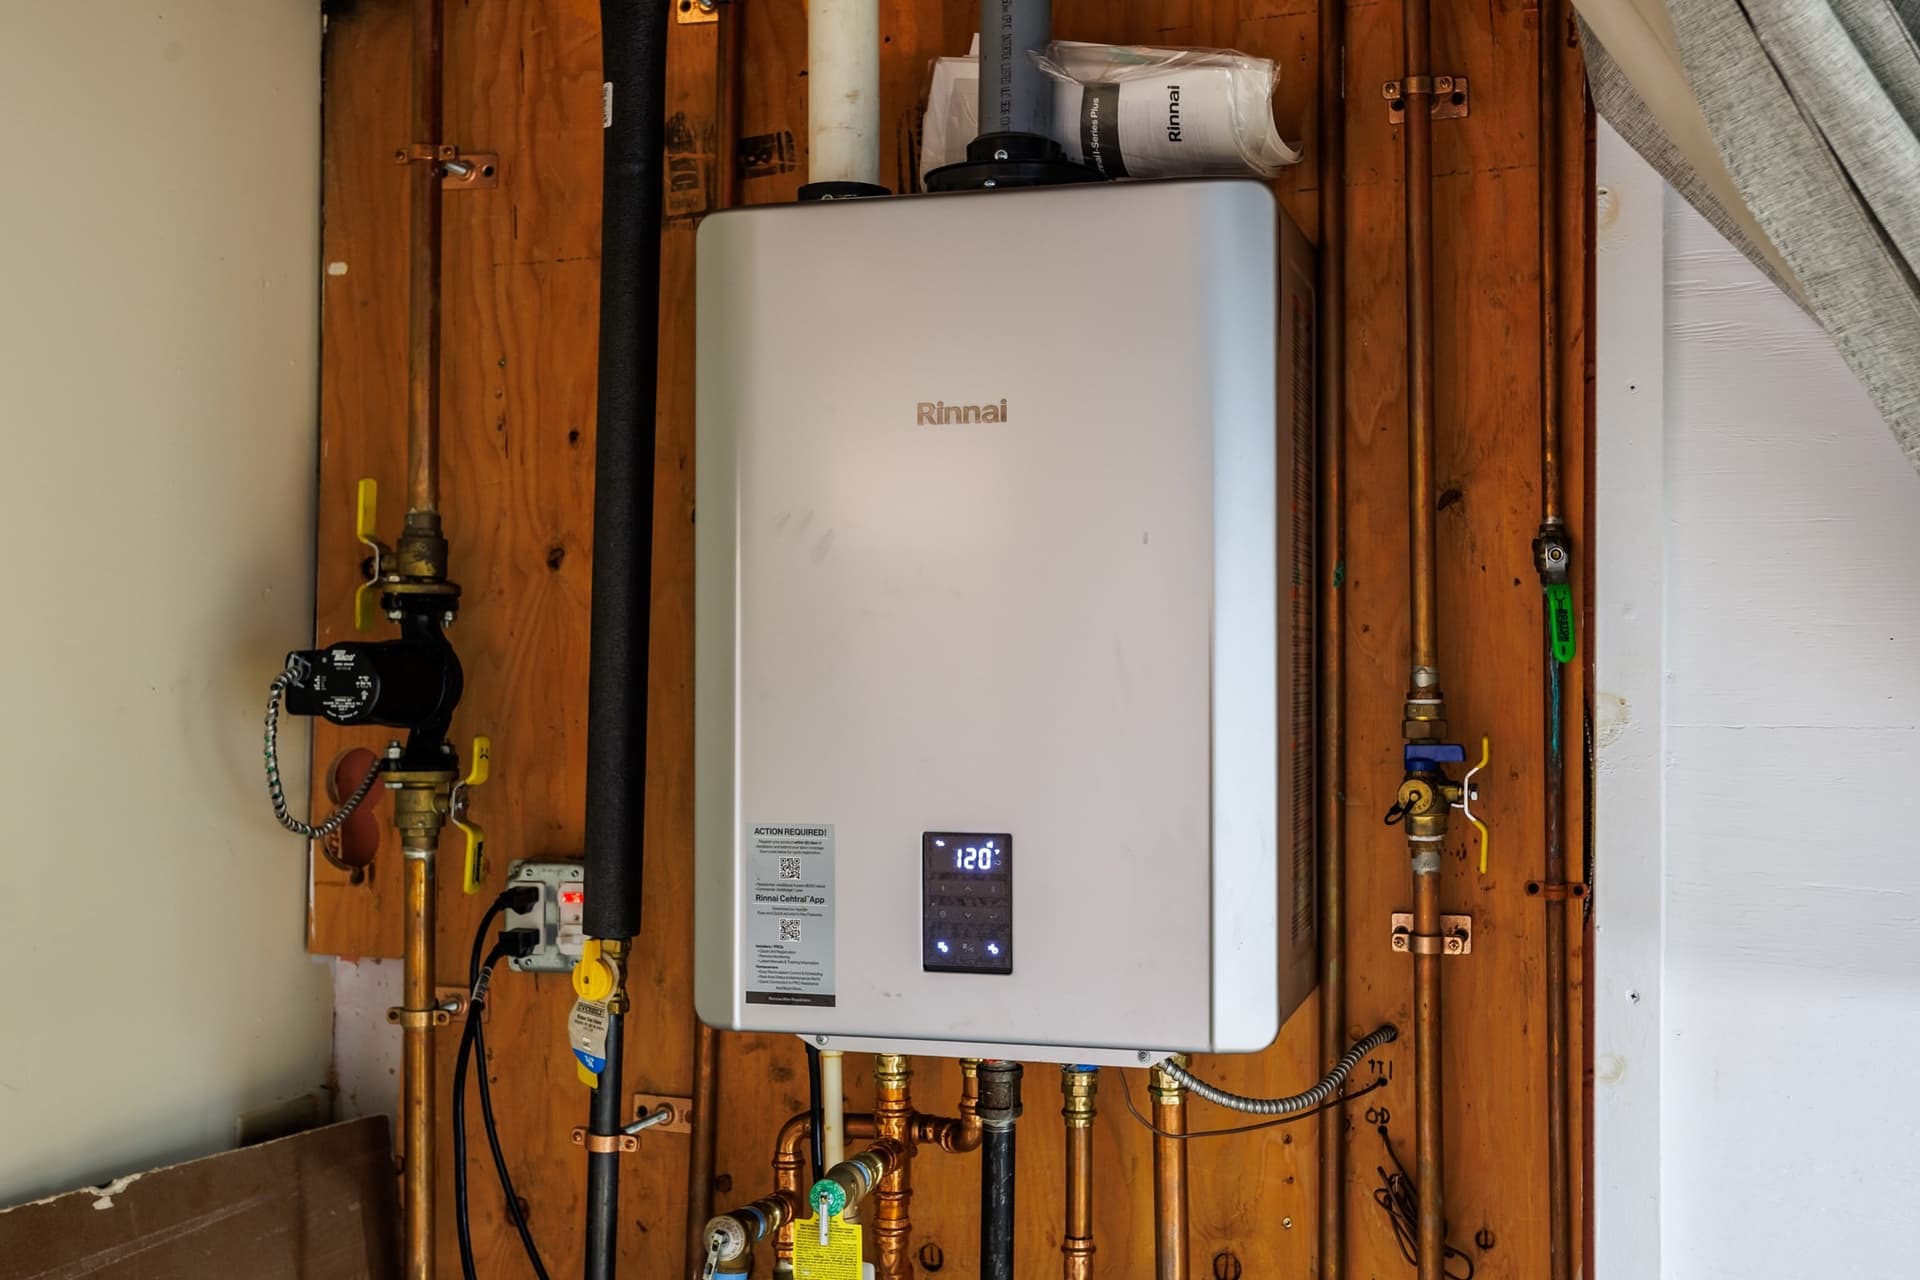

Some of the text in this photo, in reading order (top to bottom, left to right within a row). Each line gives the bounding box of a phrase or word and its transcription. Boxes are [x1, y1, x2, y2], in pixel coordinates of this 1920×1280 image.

[1090, 97, 1100, 118] Plus
[1167, 85, 1182, 142] Rinnai
[917, 398, 1007, 426] Rinnai
[754, 827, 827, 837] ACTION REQUIRED!
[755, 894, 779, 902] Rinnai
[809, 896, 825, 904] App
